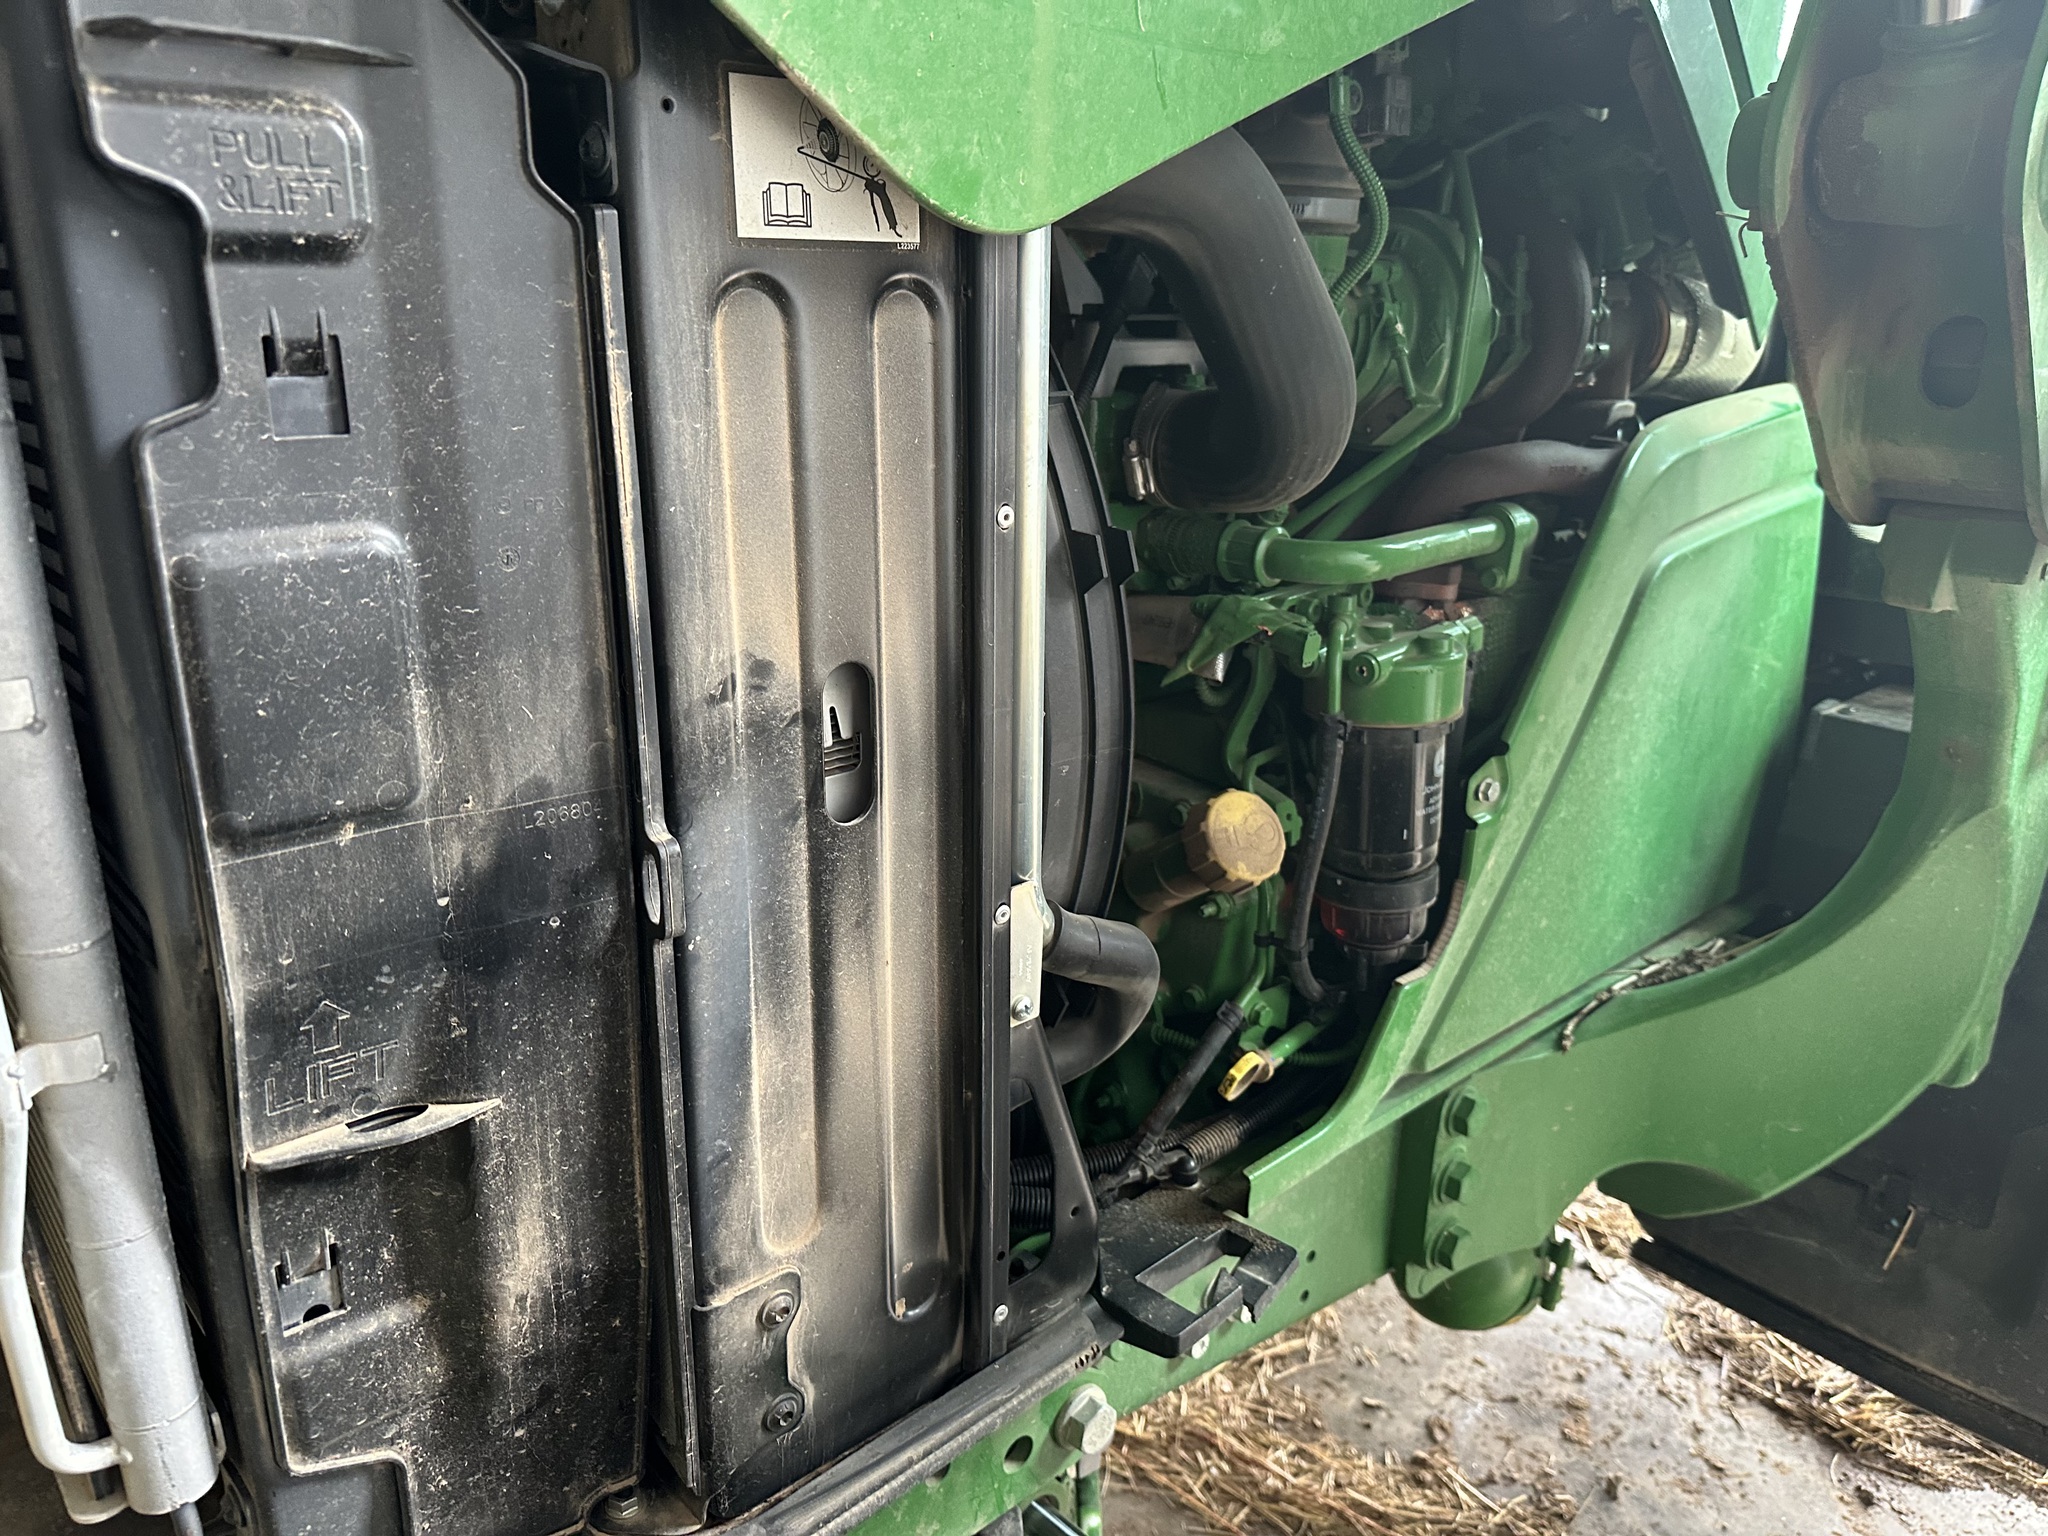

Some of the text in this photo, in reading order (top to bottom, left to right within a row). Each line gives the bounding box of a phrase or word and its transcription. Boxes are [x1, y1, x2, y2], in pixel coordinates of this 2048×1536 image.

[208, 126, 333, 174] PULL
[216, 174, 342, 217] &LIFT
[264, 1039, 400, 1116] LIFT
